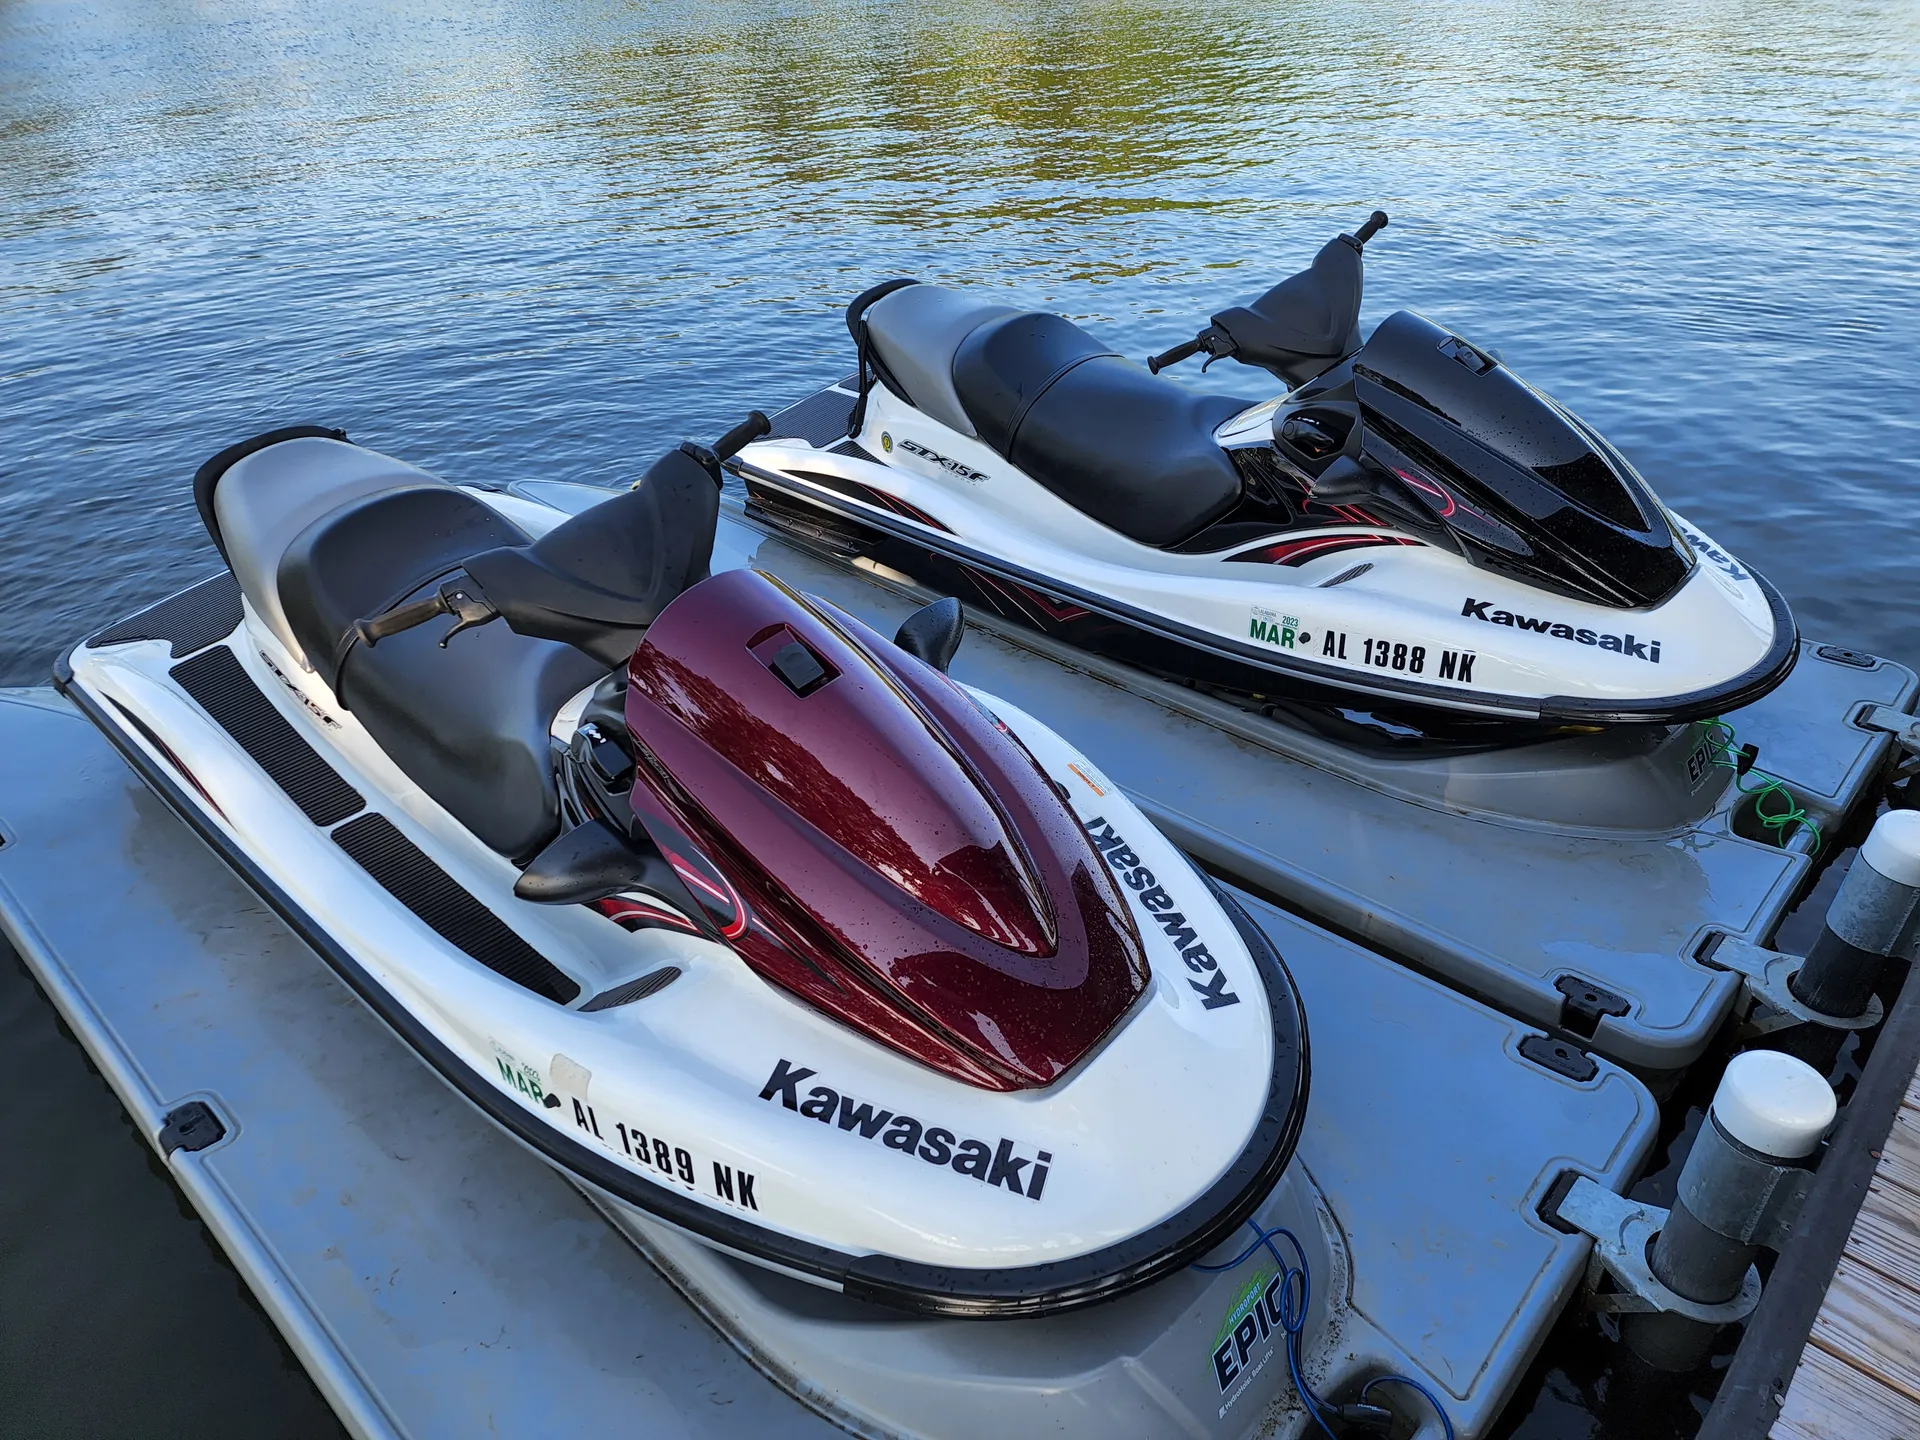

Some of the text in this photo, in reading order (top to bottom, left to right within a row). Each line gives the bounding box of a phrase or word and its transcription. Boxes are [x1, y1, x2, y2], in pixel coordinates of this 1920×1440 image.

[1250, 618, 1295, 649] MAR
[1282, 615, 1299, 627] 2023
[1461, 598, 1661, 664] Kawasaki
[1322, 630, 1477, 683] AL 1388 NK
[1086, 816, 1241, 1010] Kawasaki
[496, 1056, 545, 1104] MAR
[571, 1096, 759, 1212] AL 1389 NK
[758, 1058, 1053, 1201] Kawasaki
[1229, 1281, 1261, 1325] HYDROPORT
[1212, 1272, 1283, 1396] EPIC
